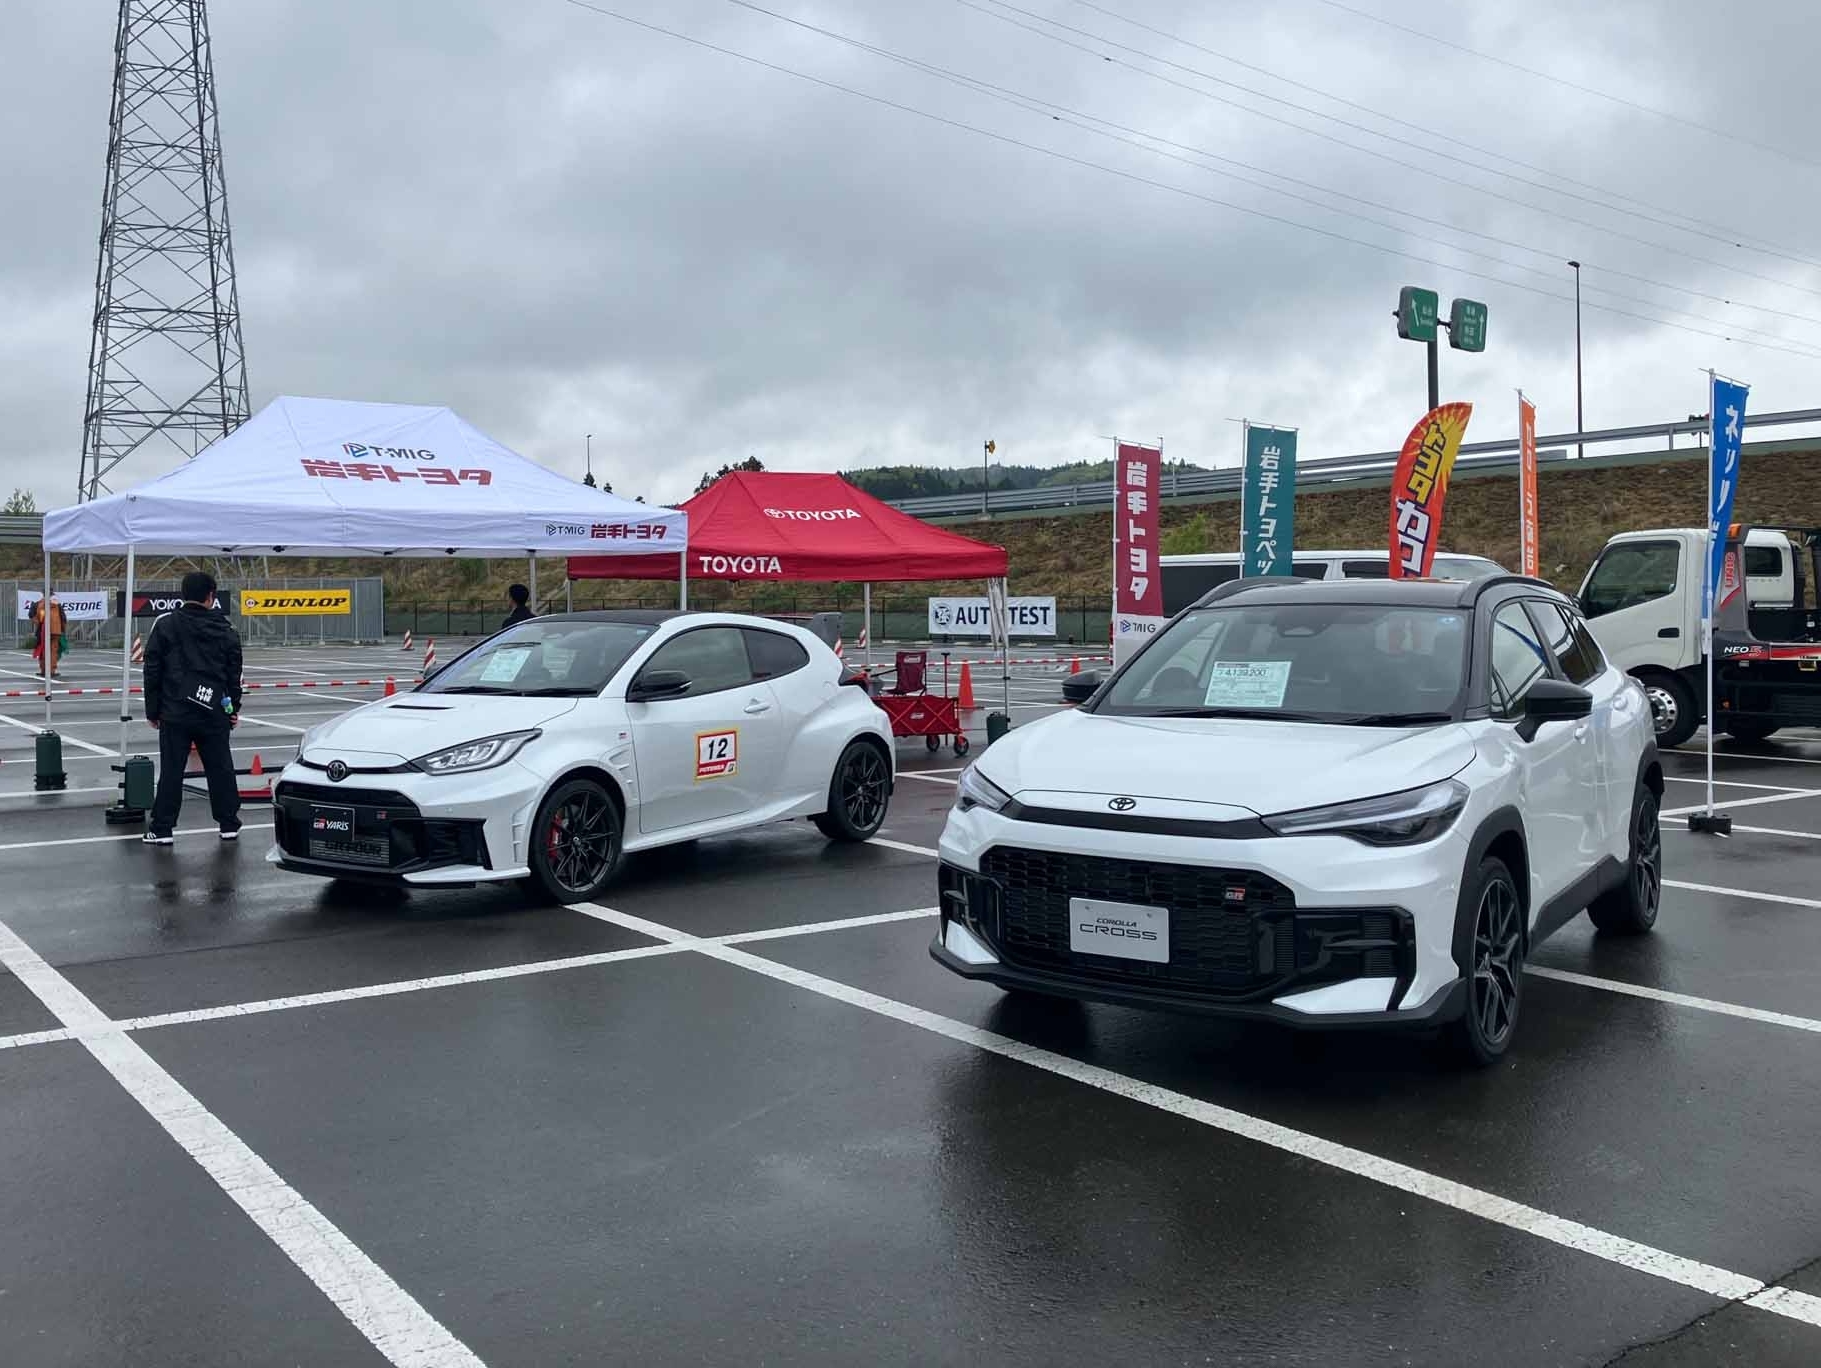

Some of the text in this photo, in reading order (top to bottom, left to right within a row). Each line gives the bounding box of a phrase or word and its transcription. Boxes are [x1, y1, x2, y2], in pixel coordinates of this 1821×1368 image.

[300, 459, 492, 486] 岩手トヨタ
[783, 508, 861, 521] TOYOTA
[1256, 446, 1280, 575] 岩手トヨペッ
[590, 523, 667, 539] 岩手トヨタ
[1126, 461, 1149, 600] 岩手トヨタ
[699, 556, 782, 573] TOYOTA
[149, 599, 222, 610] YOKOA
[261, 597, 347, 608] DUNLOP
[955, 606, 993, 625] AUT
[1008, 606, 1051, 625] TEST
[708, 737, 728, 760] 12
[326, 820, 349, 831] YARIS
[1096, 917, 1137, 927] COROLLA
[1080, 923, 1157, 940] CROSS
